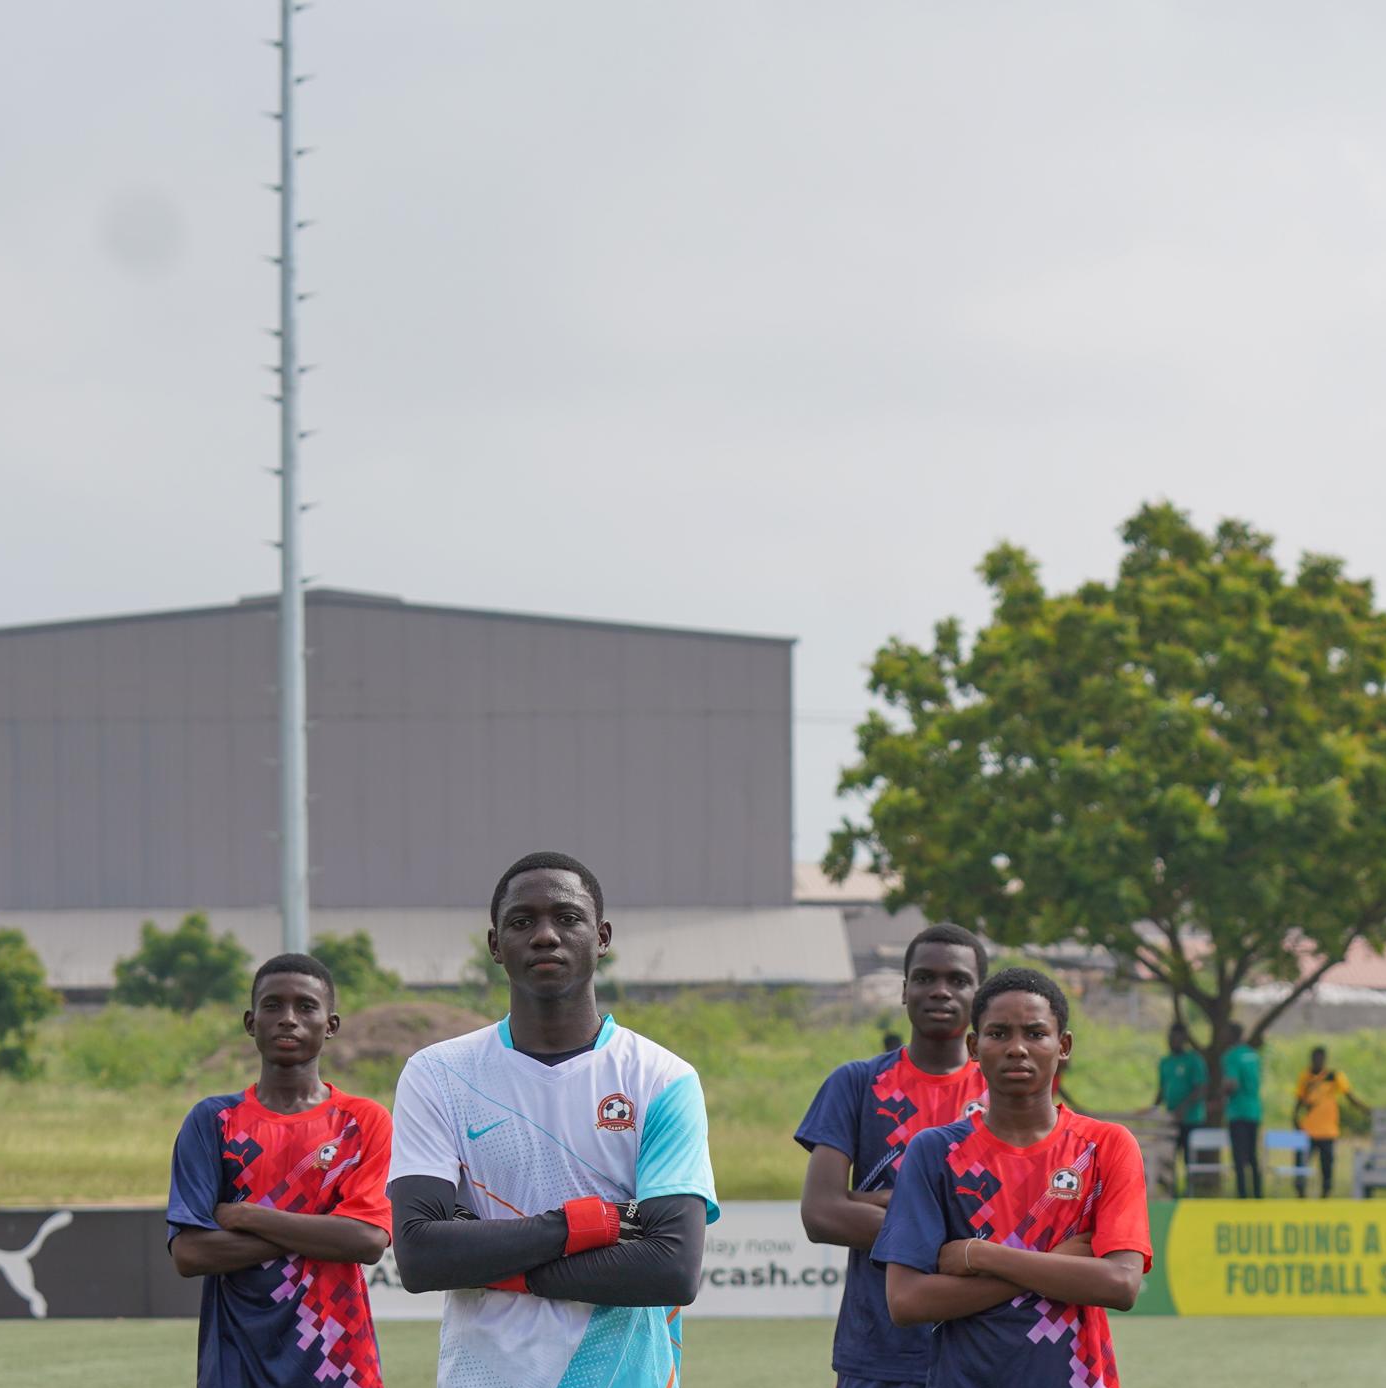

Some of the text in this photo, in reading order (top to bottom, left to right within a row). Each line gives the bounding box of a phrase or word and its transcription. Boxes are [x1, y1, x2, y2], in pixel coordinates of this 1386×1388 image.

[745, 1239, 795, 1254] now
[1216, 1222, 1351, 1255] BUILDING
[1363, 1222, 1381, 1254] A
[1226, 1263, 1368, 1295] FOOTBALL
